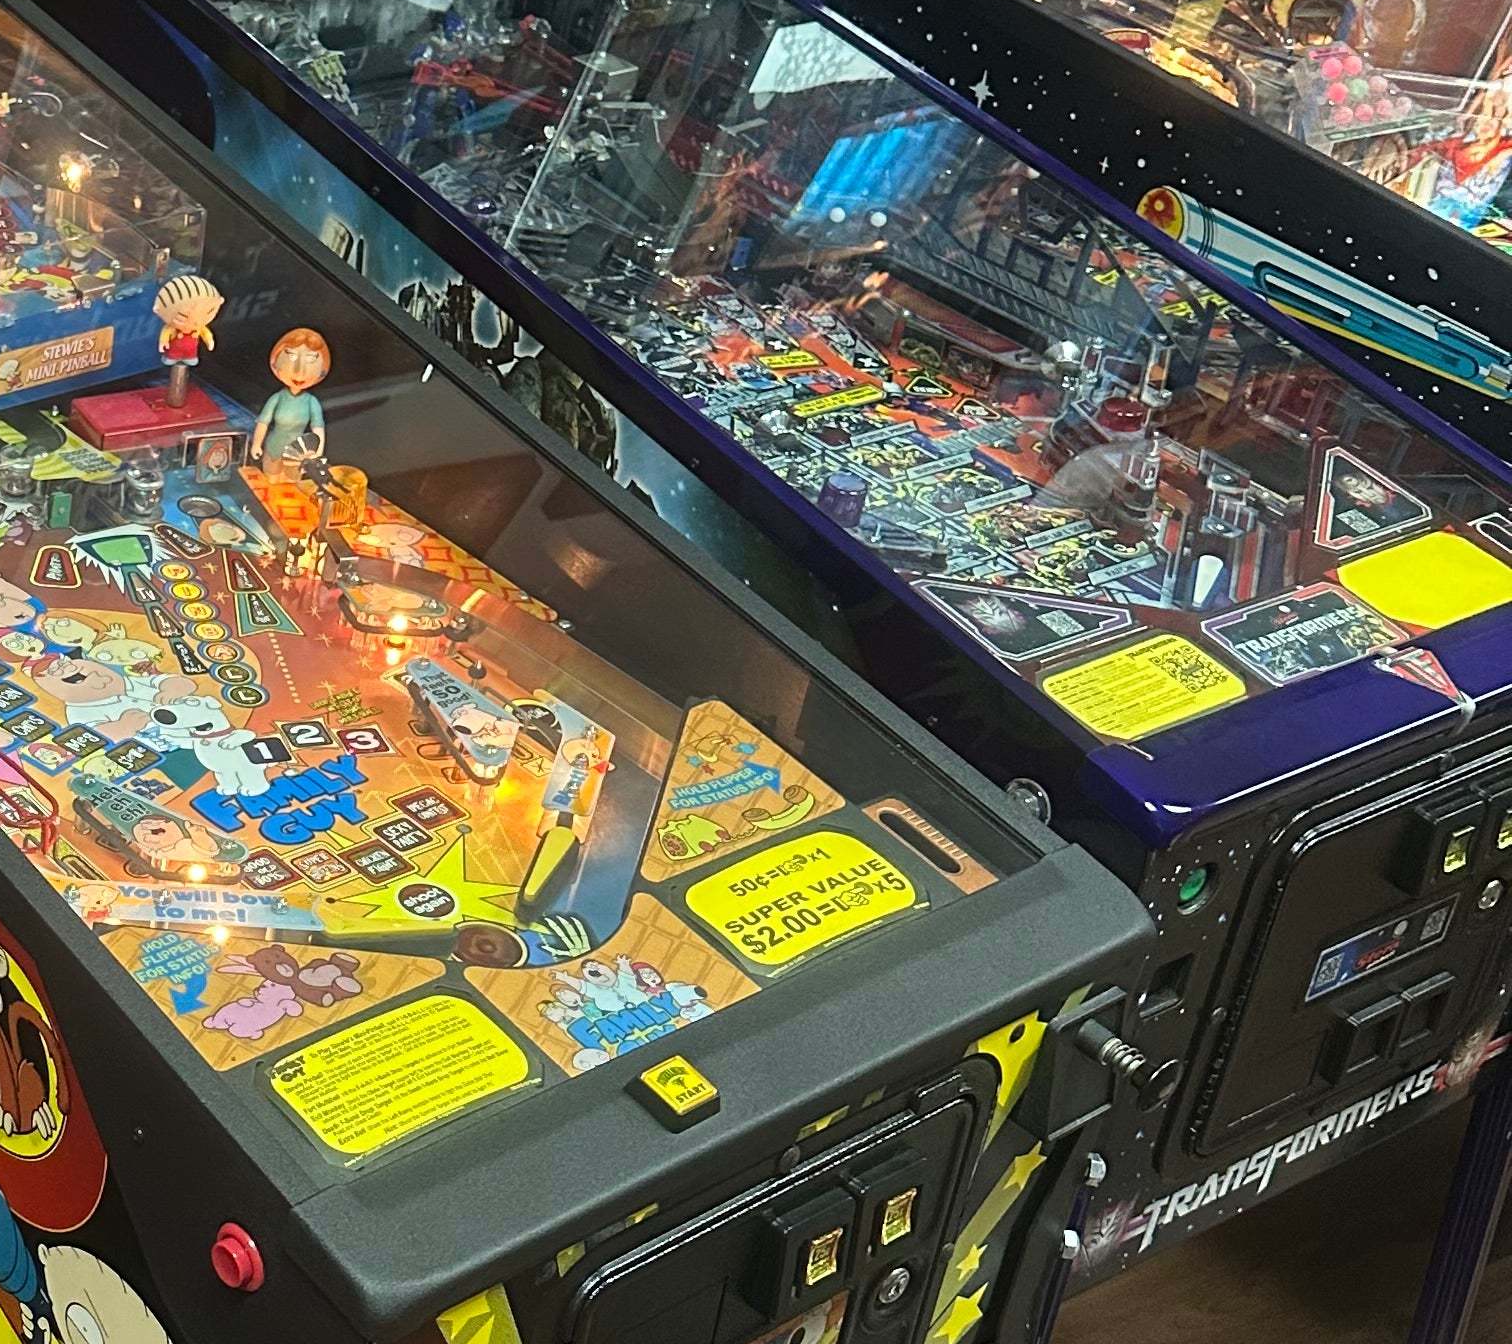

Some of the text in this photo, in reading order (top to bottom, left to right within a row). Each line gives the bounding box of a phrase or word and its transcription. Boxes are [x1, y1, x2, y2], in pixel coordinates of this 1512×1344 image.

[41, 335, 96, 362] STEWIE'S
[1234, 605, 1361, 661] TRANSFORMERS
[422, 670, 449, 685] That
[191, 754, 370, 835] FAMILY
[668, 771, 777, 811] FOR STATUS INFO!
[674, 767, 757, 800] HOLD FLIPPER
[90, 784, 123, 808] Heh
[109, 795, 132, 812] eh
[119, 802, 152, 823] eh!
[258, 792, 369, 845] GUY
[382, 821, 414, 840] SEXY
[394, 830, 429, 849] PARTY
[172, 888, 217, 904] will
[877, 873, 907, 895] x5
[403, 887, 443, 907] shoot
[413, 896, 452, 915] again
[724, 858, 887, 935] SUPER VALUE
[154, 905, 246, 923] to me!
[141, 933, 178, 953] HOLD
[141, 939, 200, 967] FLIPPER
[136, 943, 219, 984] FOR STATUS
[171, 962, 209, 986] INFO!
[568, 991, 682, 1052] FAMILY
[675, 1082, 707, 1104] START
[1138, 1061, 1442, 1253] TRANSFORMERS
